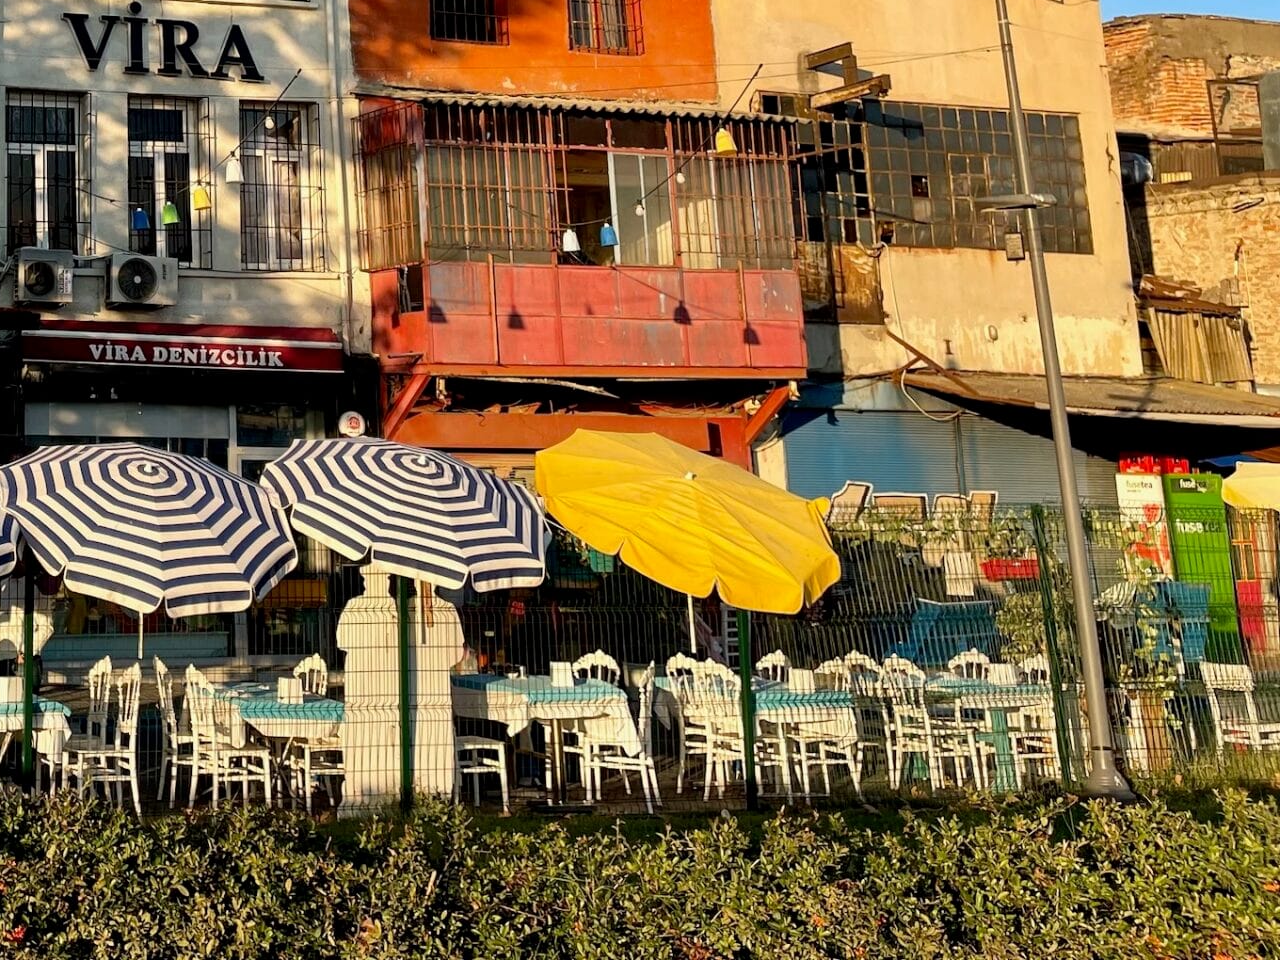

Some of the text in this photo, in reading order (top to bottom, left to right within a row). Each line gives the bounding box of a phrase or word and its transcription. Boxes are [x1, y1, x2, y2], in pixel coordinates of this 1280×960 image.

[61, 1, 265, 82] VİRA
[89, 341, 284, 367] VİRA DENİZCİLİK
